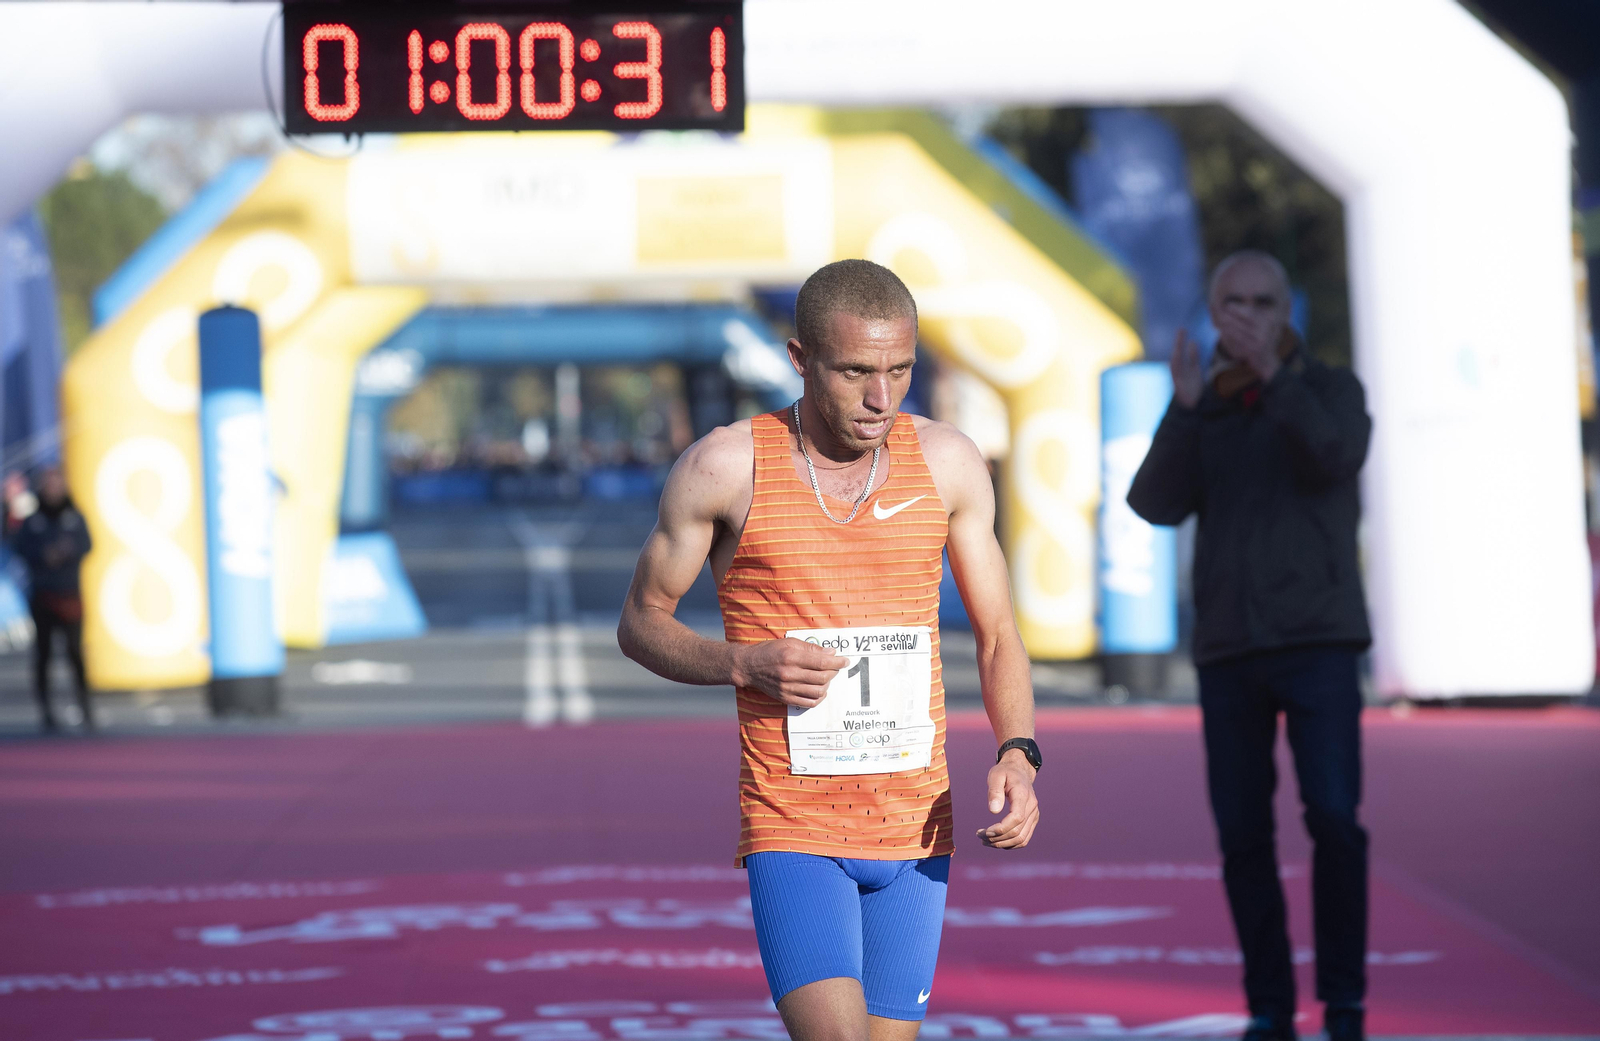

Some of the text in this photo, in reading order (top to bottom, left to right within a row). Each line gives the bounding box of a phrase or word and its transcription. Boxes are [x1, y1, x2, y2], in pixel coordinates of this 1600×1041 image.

[822, 635, 849, 652] edp
[868, 632, 911, 642] maratón
[848, 657, 870, 707] 1
[843, 719, 896, 731] Walelegn
[866, 731, 890, 746] edp
